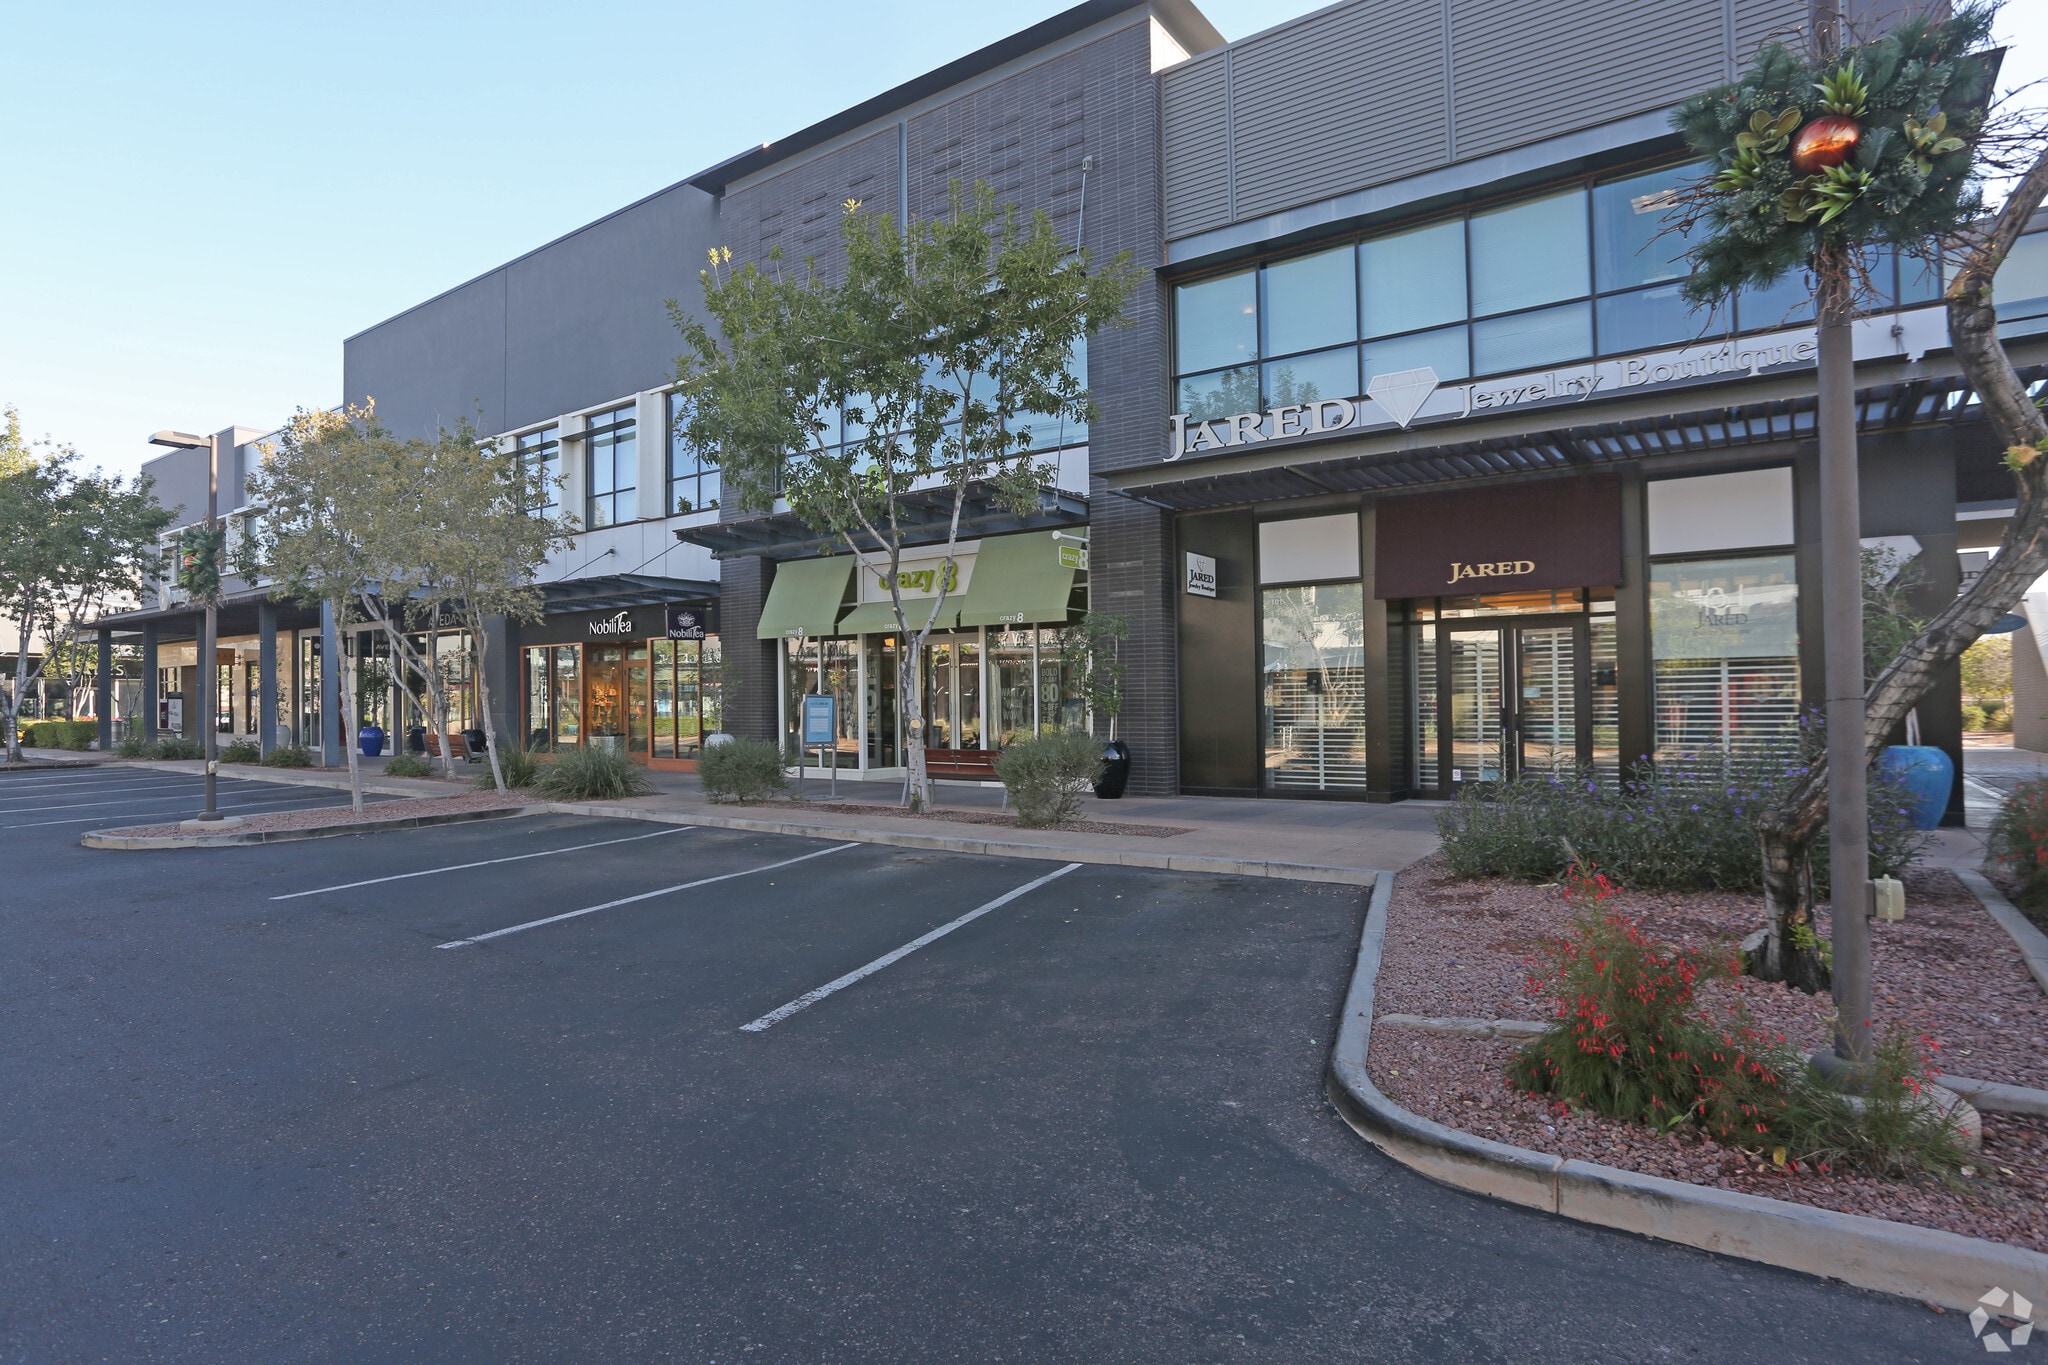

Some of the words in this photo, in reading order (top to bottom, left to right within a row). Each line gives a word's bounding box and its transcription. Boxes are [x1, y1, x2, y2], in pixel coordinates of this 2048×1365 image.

[1163, 399, 1356, 463] JARED
[1454, 371, 1604, 419] Jewelry
[1617, 340, 1818, 388] Boutique
[1062, 552, 1078, 564] crazy
[1079, 549, 1089, 570] 8
[879, 569, 935, 592] cazy
[936, 560, 958, 592] 8
[1189, 569, 1215, 584] JARED
[1447, 560, 1535, 584] JARED
[427, 613, 457, 628] AEDA
[589, 611, 632, 635] NobiliTea
[1017, 612, 1024, 623] 8
[669, 625, 704, 639] NobiliTea
[798, 626, 803, 636] 8
[1041, 667, 1057, 677] BOLD
[1041, 683, 1059, 703] 80
